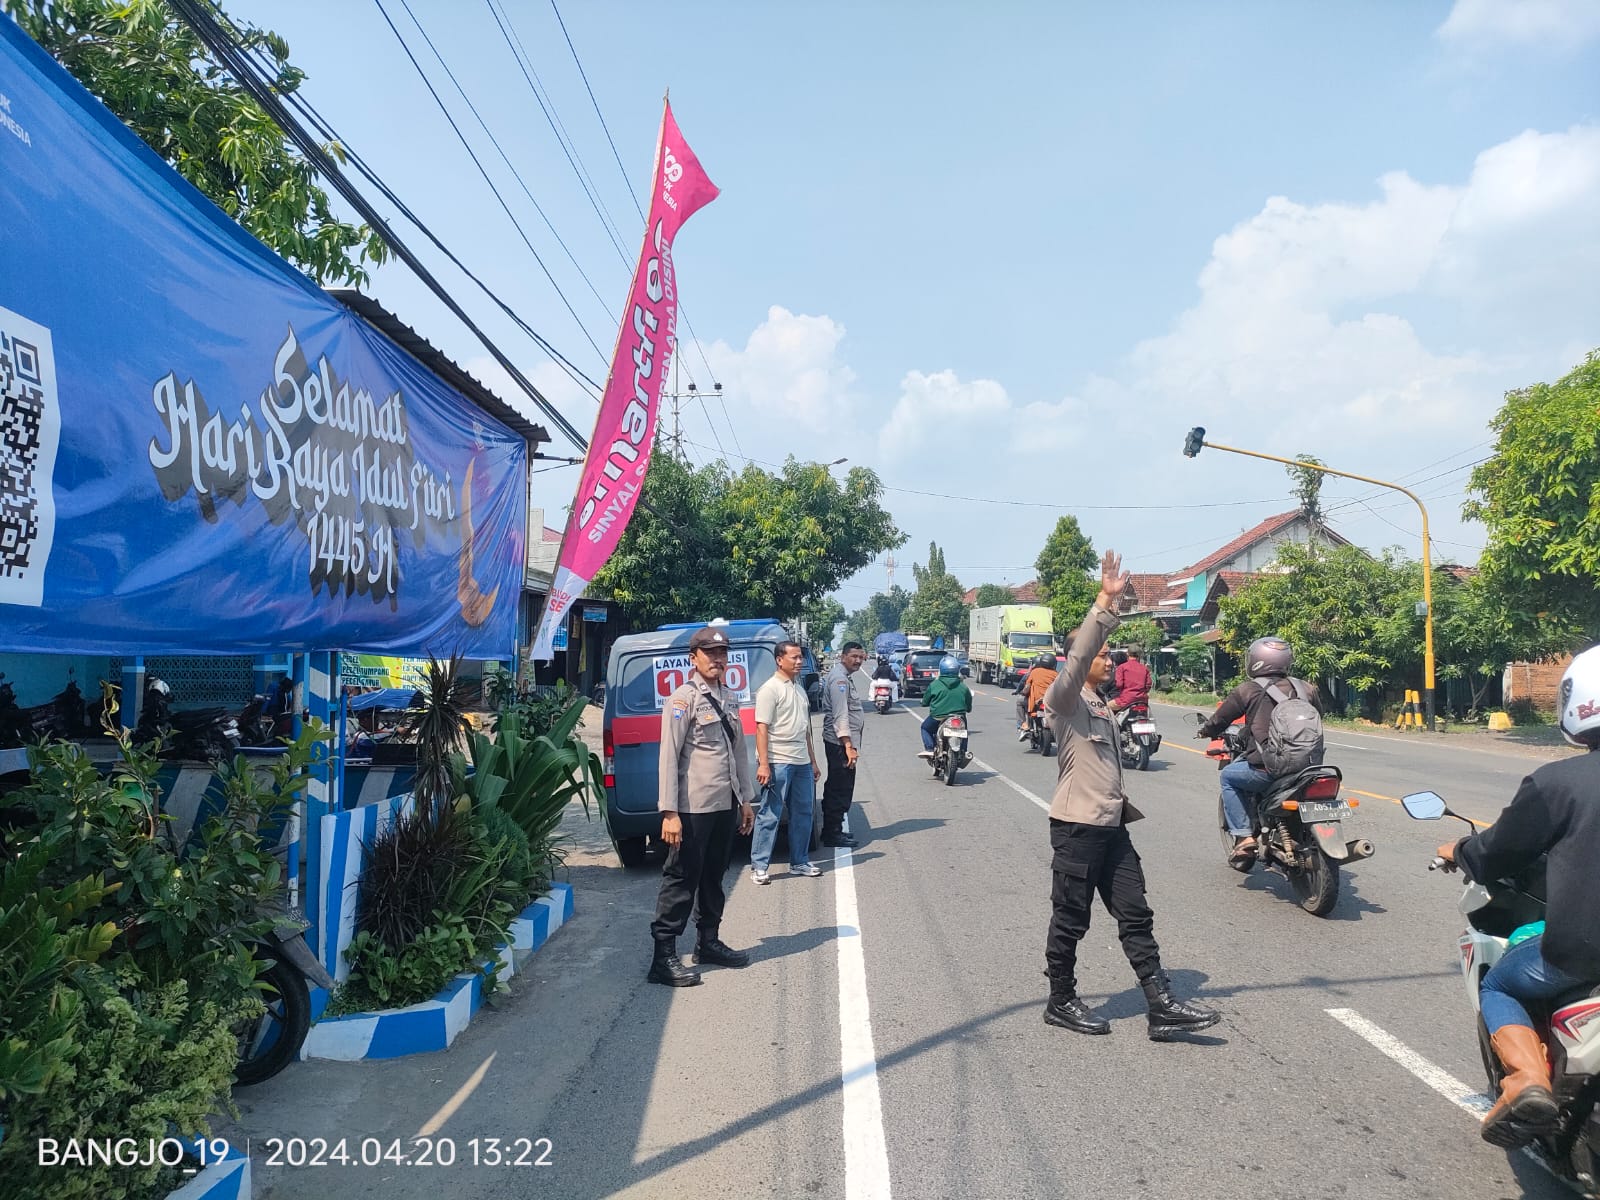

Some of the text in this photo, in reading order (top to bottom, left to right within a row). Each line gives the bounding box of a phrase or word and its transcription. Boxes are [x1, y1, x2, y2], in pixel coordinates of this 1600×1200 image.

[149, 370, 455, 530] Hari Raya Idul Fitri
[268, 320, 406, 445] Selamat
[588, 481, 639, 544] SINYAL
[661, 236, 674, 302] DISINI
[306, 512, 395, 594] 1445 H
